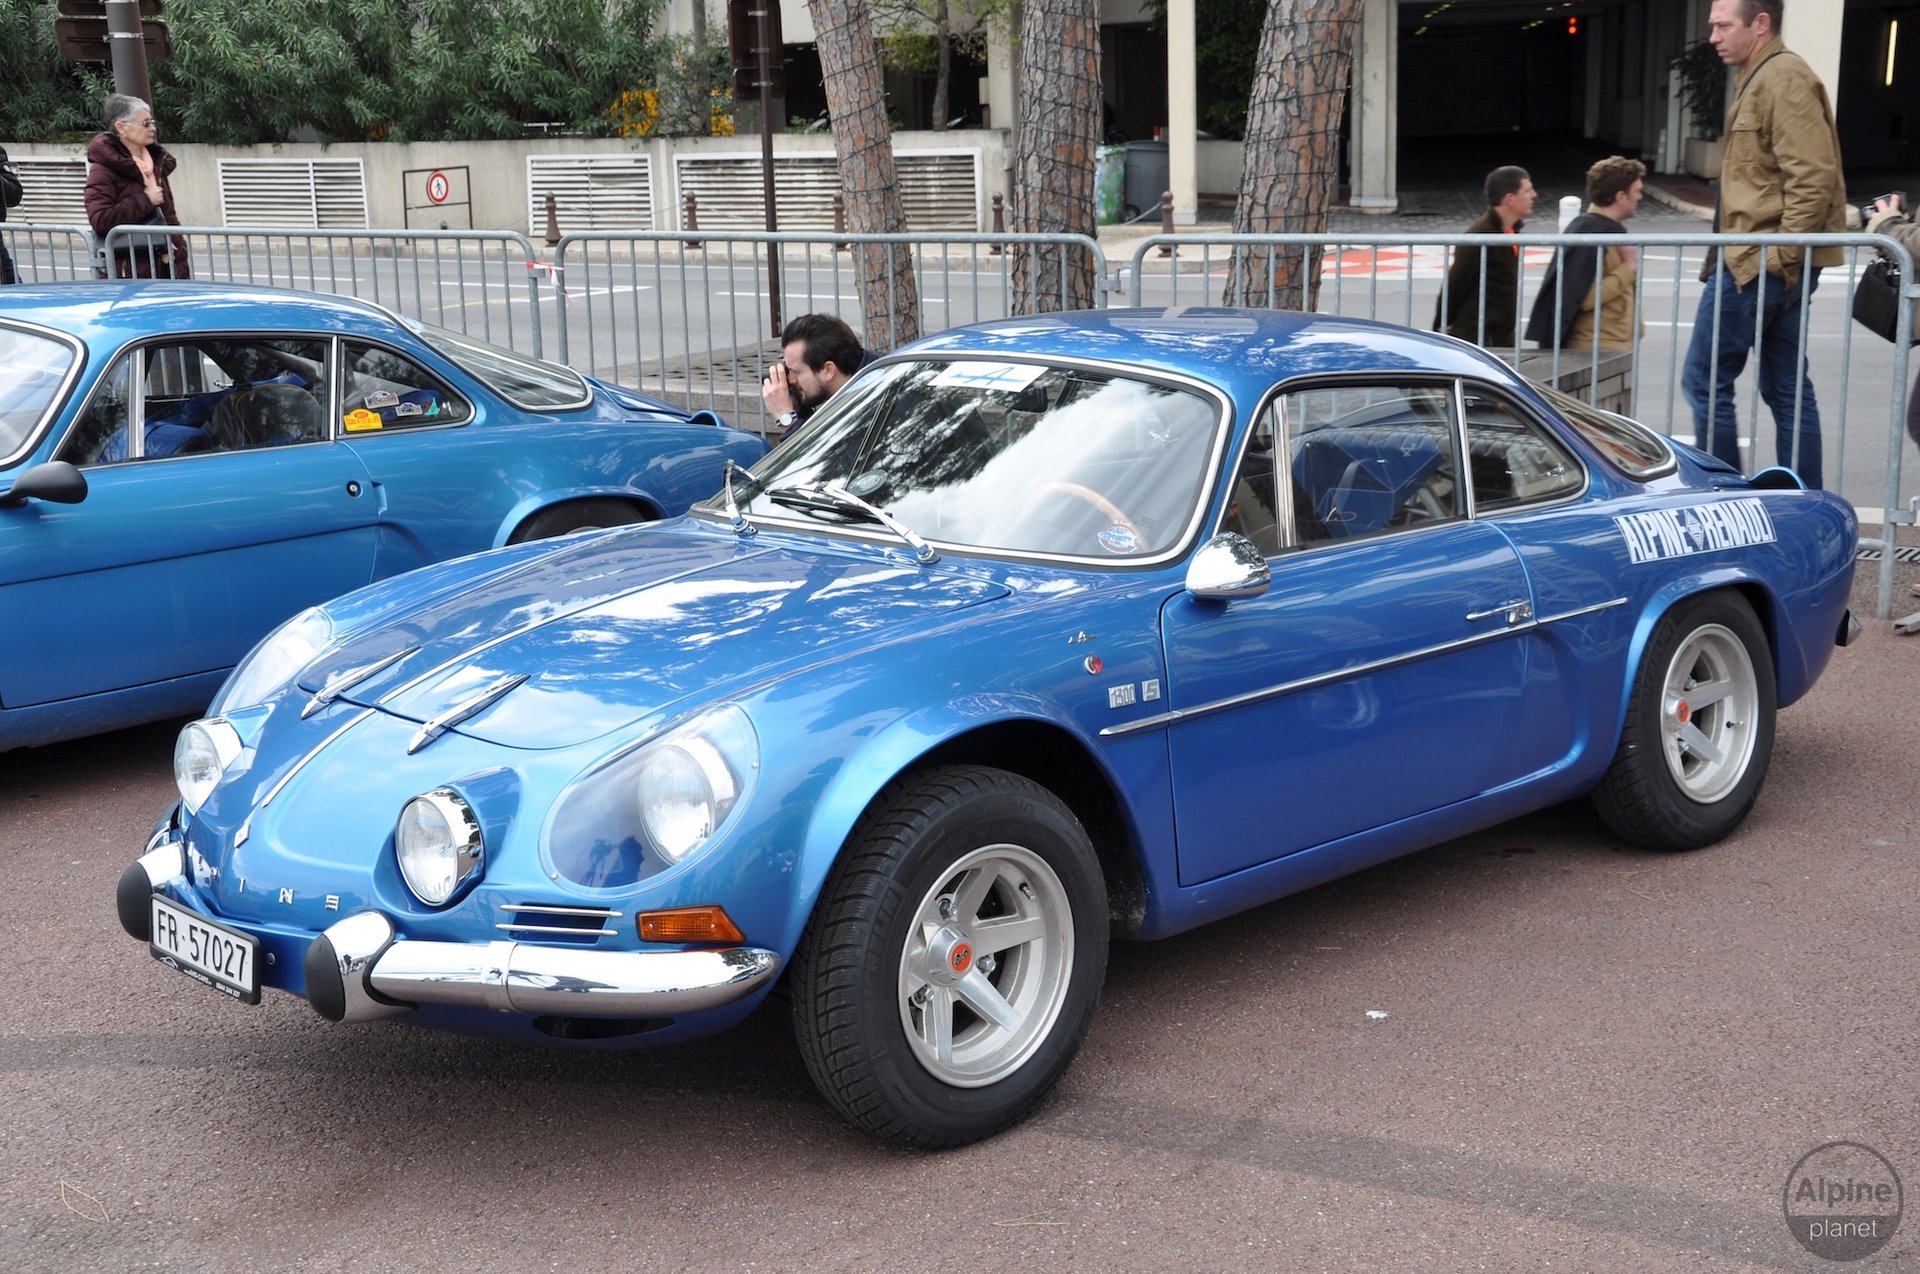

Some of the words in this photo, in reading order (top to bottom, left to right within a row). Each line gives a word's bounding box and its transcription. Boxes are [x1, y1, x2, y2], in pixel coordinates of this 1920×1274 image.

[1618, 510, 1693, 561] ALPINE
[1694, 500, 1775, 550] RENAULT
[1109, 684, 1136, 708] 1300
[158, 909, 179, 952] FR
[189, 924, 246, 982] 57027
